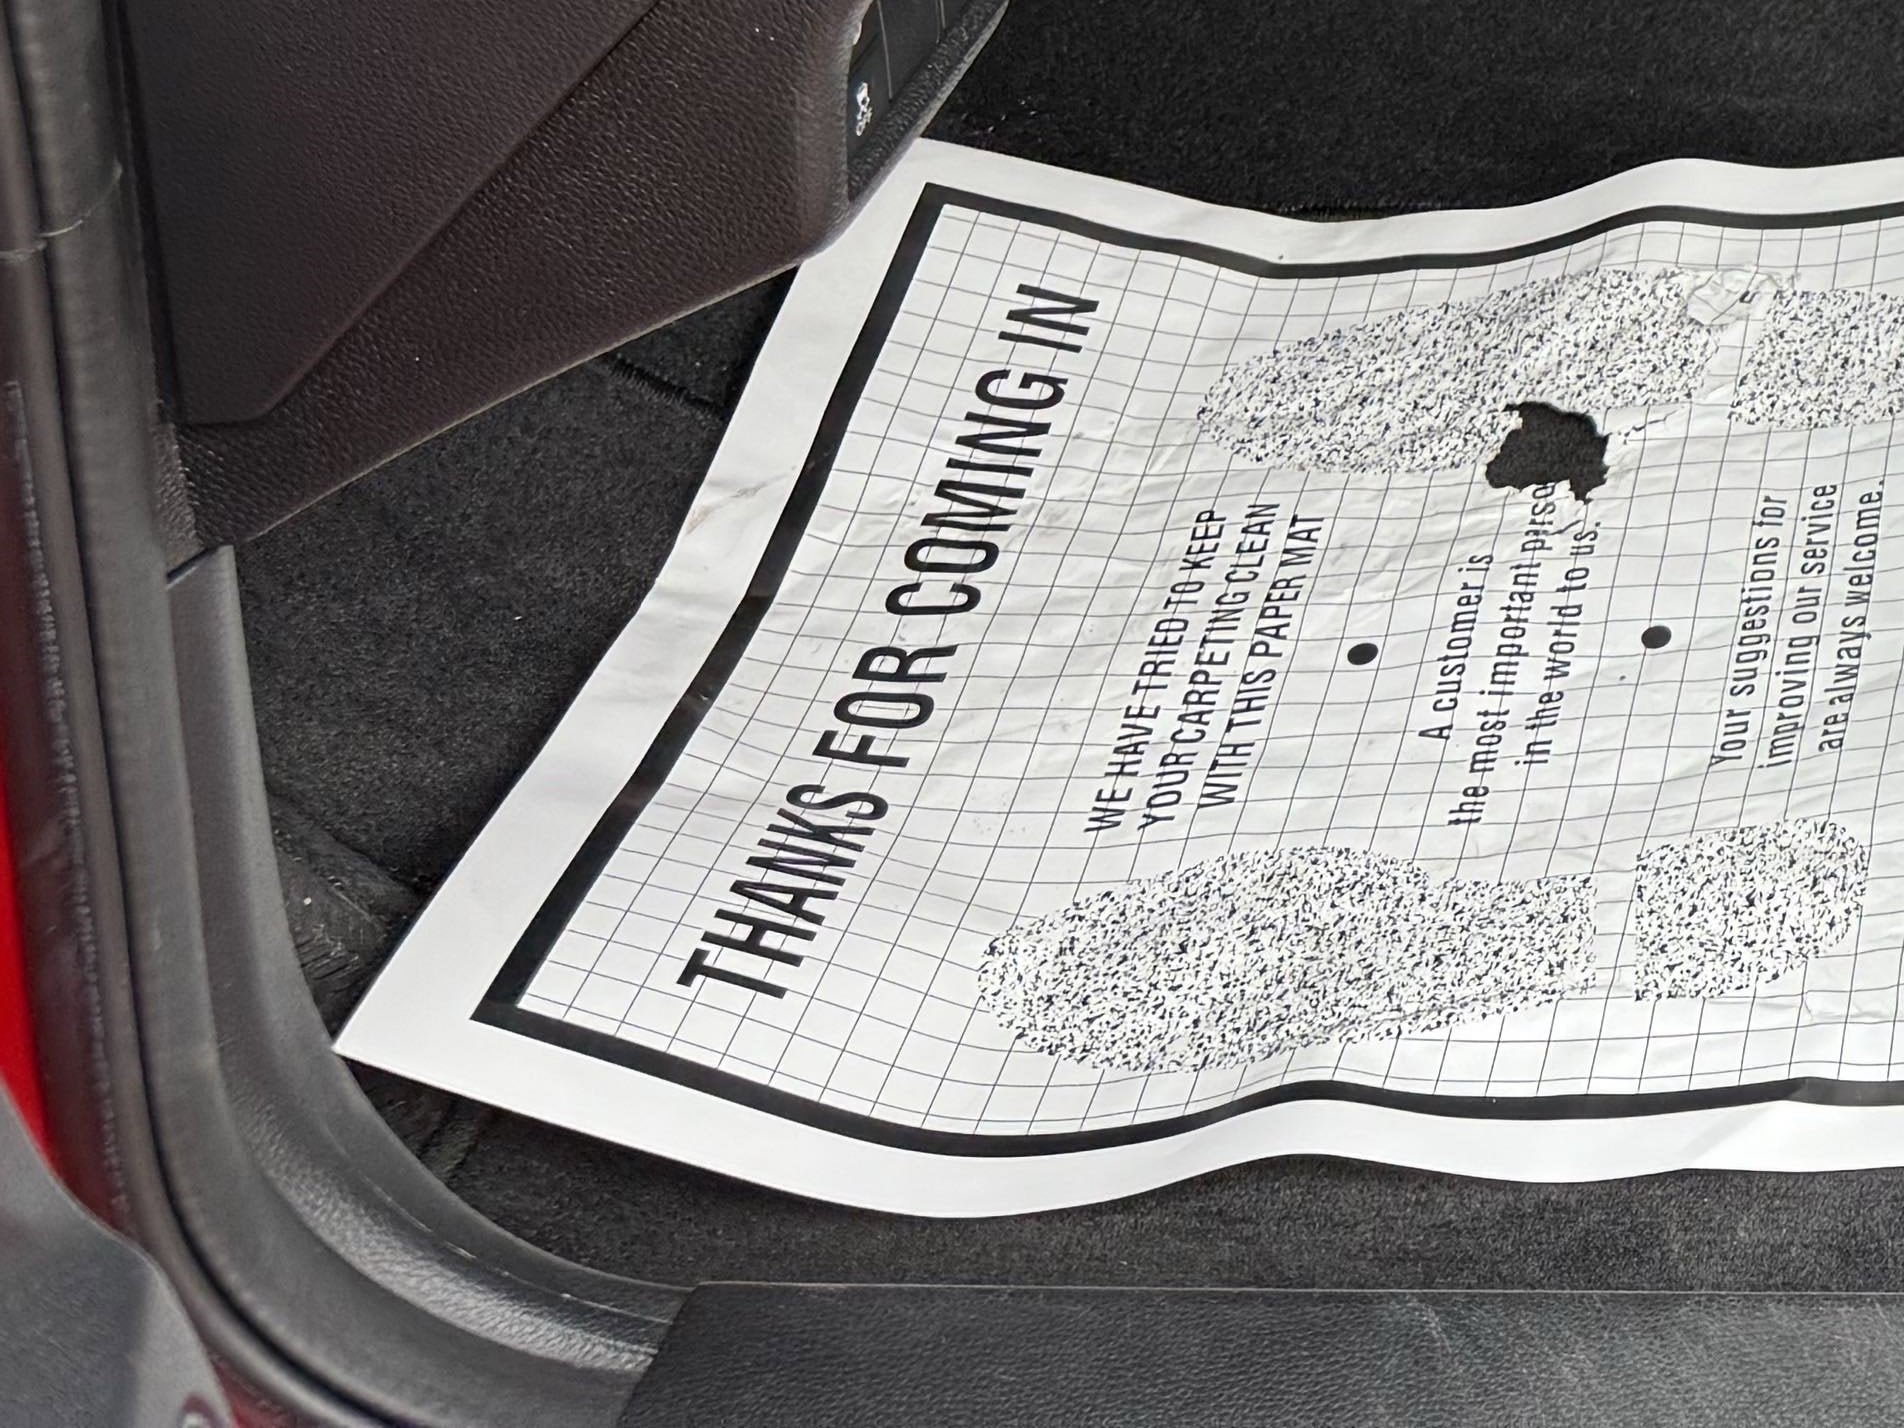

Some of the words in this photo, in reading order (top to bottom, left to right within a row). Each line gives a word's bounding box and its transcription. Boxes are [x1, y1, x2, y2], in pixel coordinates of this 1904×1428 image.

[998, 284, 1099, 352] IN
[885, 369, 1068, 616] COMING
[1752, 496, 1787, 527] for
[1179, 509, 1226, 570] KEEP
[1278, 514, 1324, 566] MAT
[1570, 521, 1601, 555] us.
[1801, 485, 1837, 574] service
[1844, 479, 1885, 606] welcome.
[1164, 581, 1205, 607] TO
[1460, 554, 1493, 572] is
[1556, 567, 1589, 591] to
[1247, 575, 1307, 658] PAPER
[1479, 562, 1541, 696] important
[1730, 537, 1780, 696] suggestions
[1792, 586, 1822, 623] our
[1133, 618, 1189, 695] TRIED
[1137, 752, 1198, 830] YOUR
[1170, 591, 1250, 744] CARPETING
[1225, 504, 1280, 582] CLEAN
[1433, 582, 1485, 711] customer
[1543, 604, 1583, 679] world
[1825, 615, 1871, 705] always
[812, 644, 960, 767] FOR
[1224, 669, 1276, 732] THIS
[1418, 725, 1453, 740] A
[1525, 691, 1564, 730] the
[1758, 635, 1820, 768] improving
[1818, 712, 1849, 751] are
[1104, 704, 1160, 777] HAVE
[1469, 709, 1509, 773] most
[1515, 740, 1552, 766] in
[1709, 709, 1751, 765] Your
[1197, 742, 1253, 808] WITH
[1448, 786, 1489, 824] the
[1084, 788, 1133, 832] WE
[676, 785, 888, 999] THANKS
